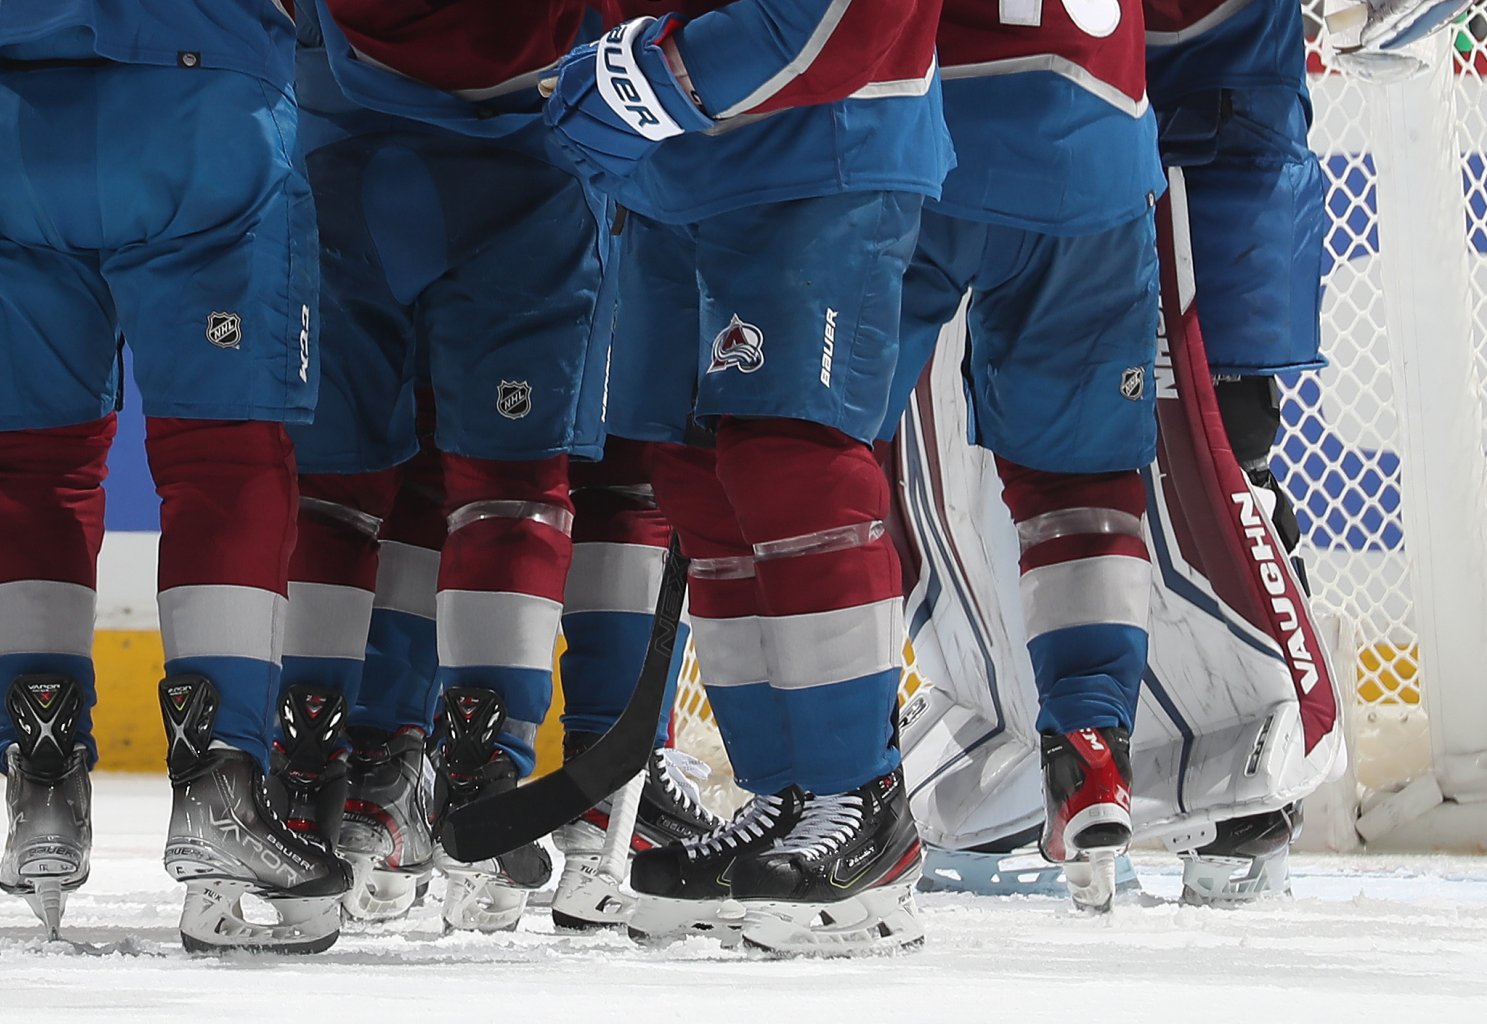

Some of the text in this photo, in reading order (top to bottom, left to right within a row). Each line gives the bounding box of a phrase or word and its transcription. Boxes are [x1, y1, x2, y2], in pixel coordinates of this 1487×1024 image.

[820, 306, 840, 389] BAUER
[1231, 491, 1320, 696] VAUGHN
[266, 833, 314, 871] BAUER
